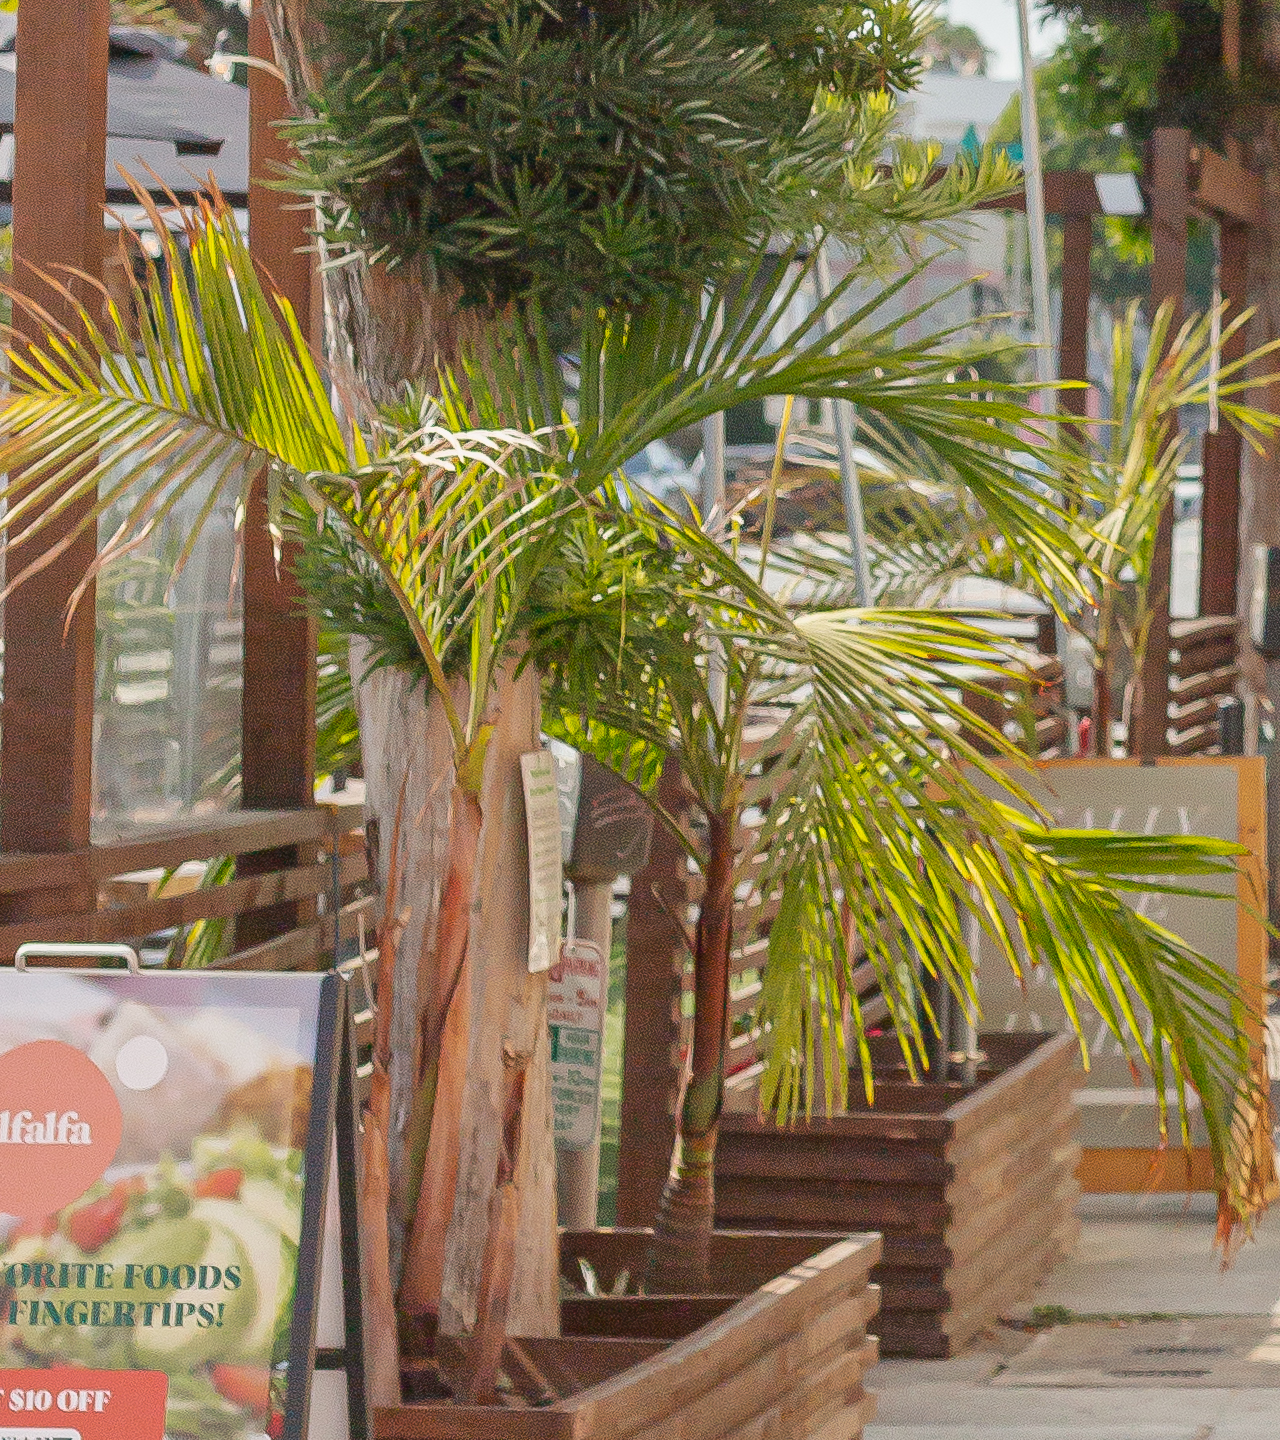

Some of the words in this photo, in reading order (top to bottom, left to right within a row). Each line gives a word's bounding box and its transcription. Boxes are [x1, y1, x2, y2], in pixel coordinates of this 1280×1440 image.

[2, 1262, 115, 1289] ORITE
[123, 1264, 242, 1291] FOODS
[8, 1299, 226, 1328] FINGERTIPS!
[56, 1389, 112, 1412] OFF
